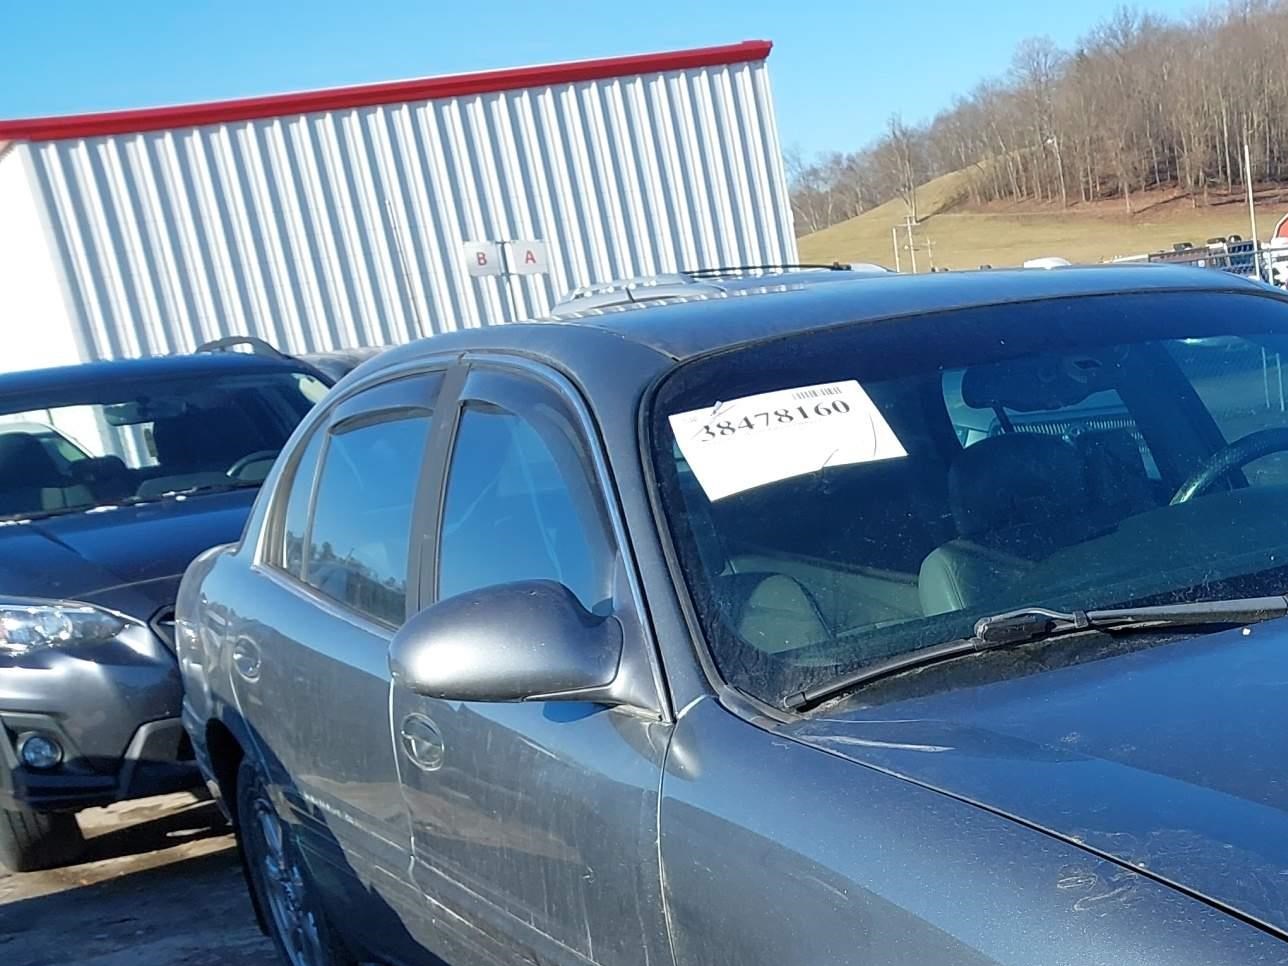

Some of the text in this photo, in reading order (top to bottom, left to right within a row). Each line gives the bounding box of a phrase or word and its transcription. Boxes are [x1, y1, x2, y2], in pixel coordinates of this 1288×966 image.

[476, 252, 488, 266] B
[525, 250, 536, 264] A
[701, 400, 851, 442] 38478160
